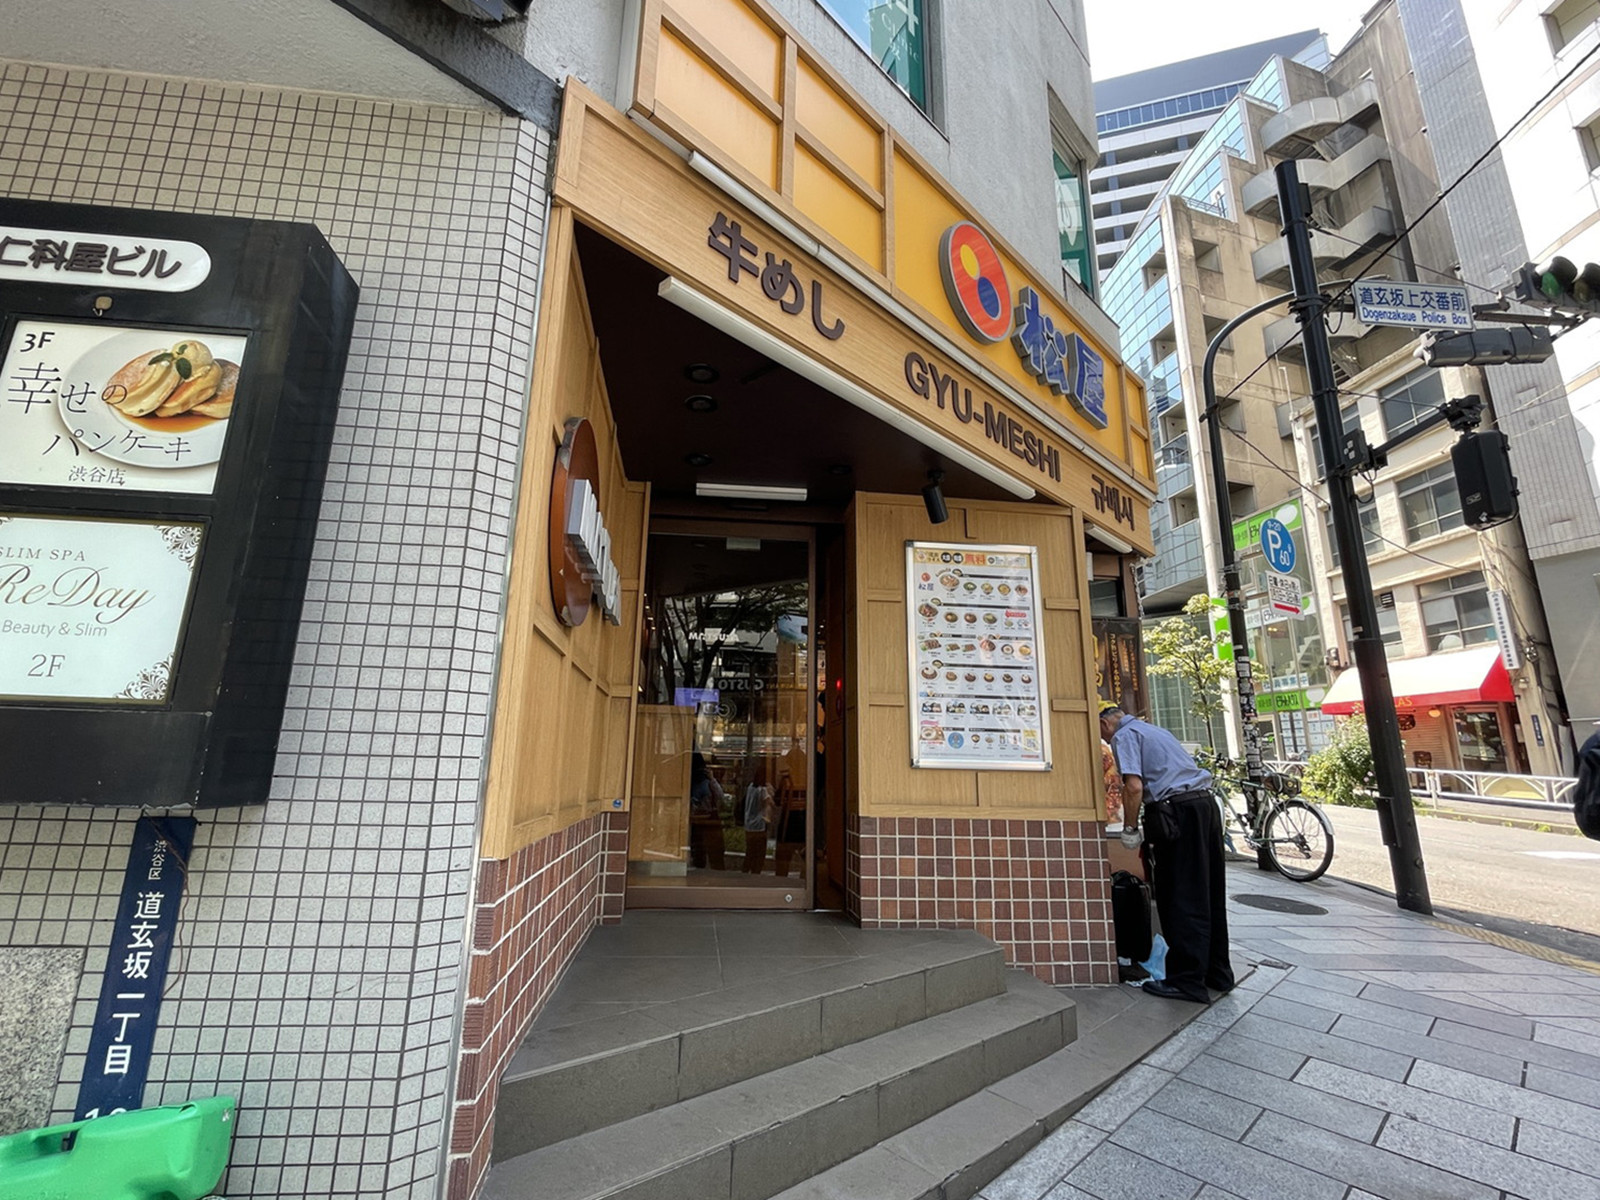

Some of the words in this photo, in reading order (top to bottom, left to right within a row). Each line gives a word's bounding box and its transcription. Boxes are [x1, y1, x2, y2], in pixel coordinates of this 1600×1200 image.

[0, 235, 182, 279] 仁科屋ビル
[708, 211, 846, 341] 牛めし
[1358, 287, 1466, 311] 道玄坂上交番前
[1362, 306, 1417, 322] Dogenzakaue
[1421, 310, 1447, 324] Police
[1451, 312, 1468, 325] Box
[20, 332, 55, 352] 3F
[1011, 286, 1108, 430] 松屋
[8, 361, 127, 414] 幸せの
[905, 351, 1061, 483] GYU-MESHI
[42, 428, 192, 462] パンケーキ
[68, 465, 126, 486] 渋谷店
[49, 549, 86, 561] SPA
[1267, 528, 1282, 564] P
[1280, 550, 1290, 567] 60
[2, 620, 55, 638] Beauty
[58, 622, 71, 636] &
[74, 623, 108, 637] Slim
[27, 653, 66, 678] 2F
[148, 839, 168, 881] 渋谷区
[103, 891, 164, 1075] 道玄坂一丁目
